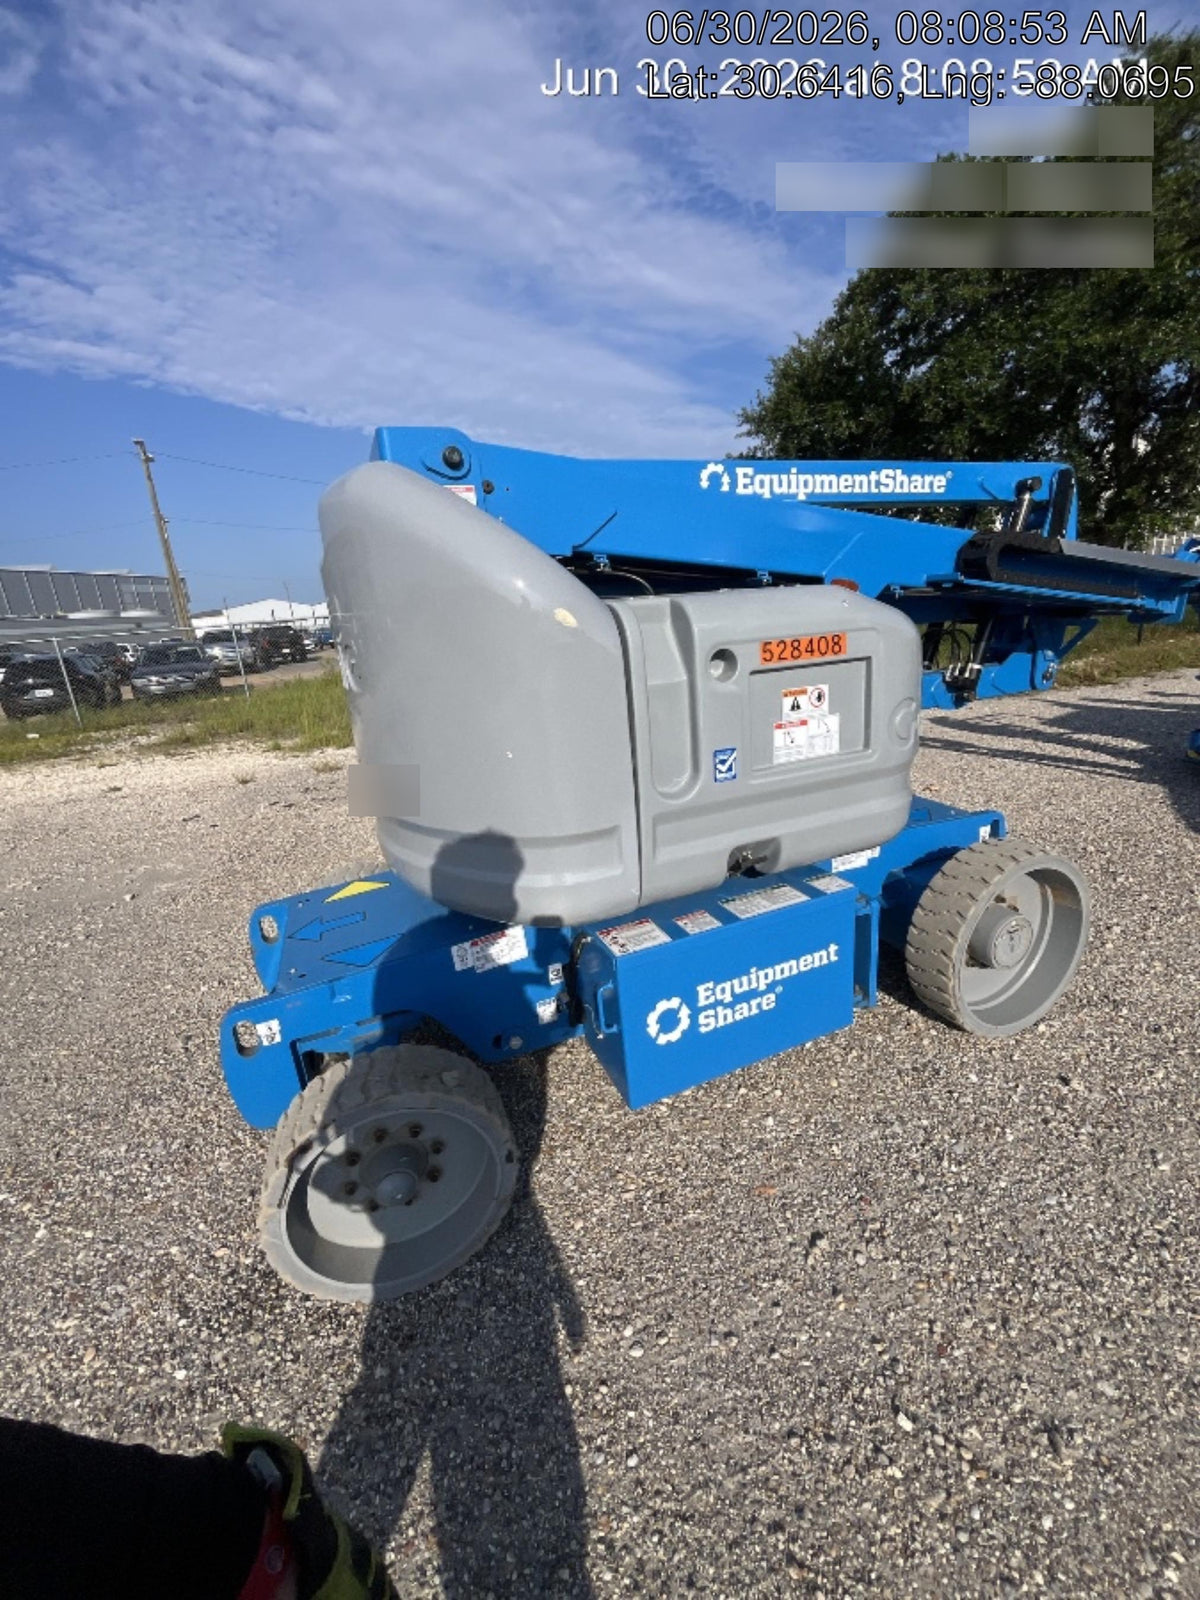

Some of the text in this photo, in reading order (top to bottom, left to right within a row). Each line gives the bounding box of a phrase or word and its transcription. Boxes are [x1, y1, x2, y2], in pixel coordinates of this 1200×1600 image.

[762, 634, 843, 663] 528408
[697, 943, 839, 1007] Equipment
[698, 992, 777, 1034] Share
